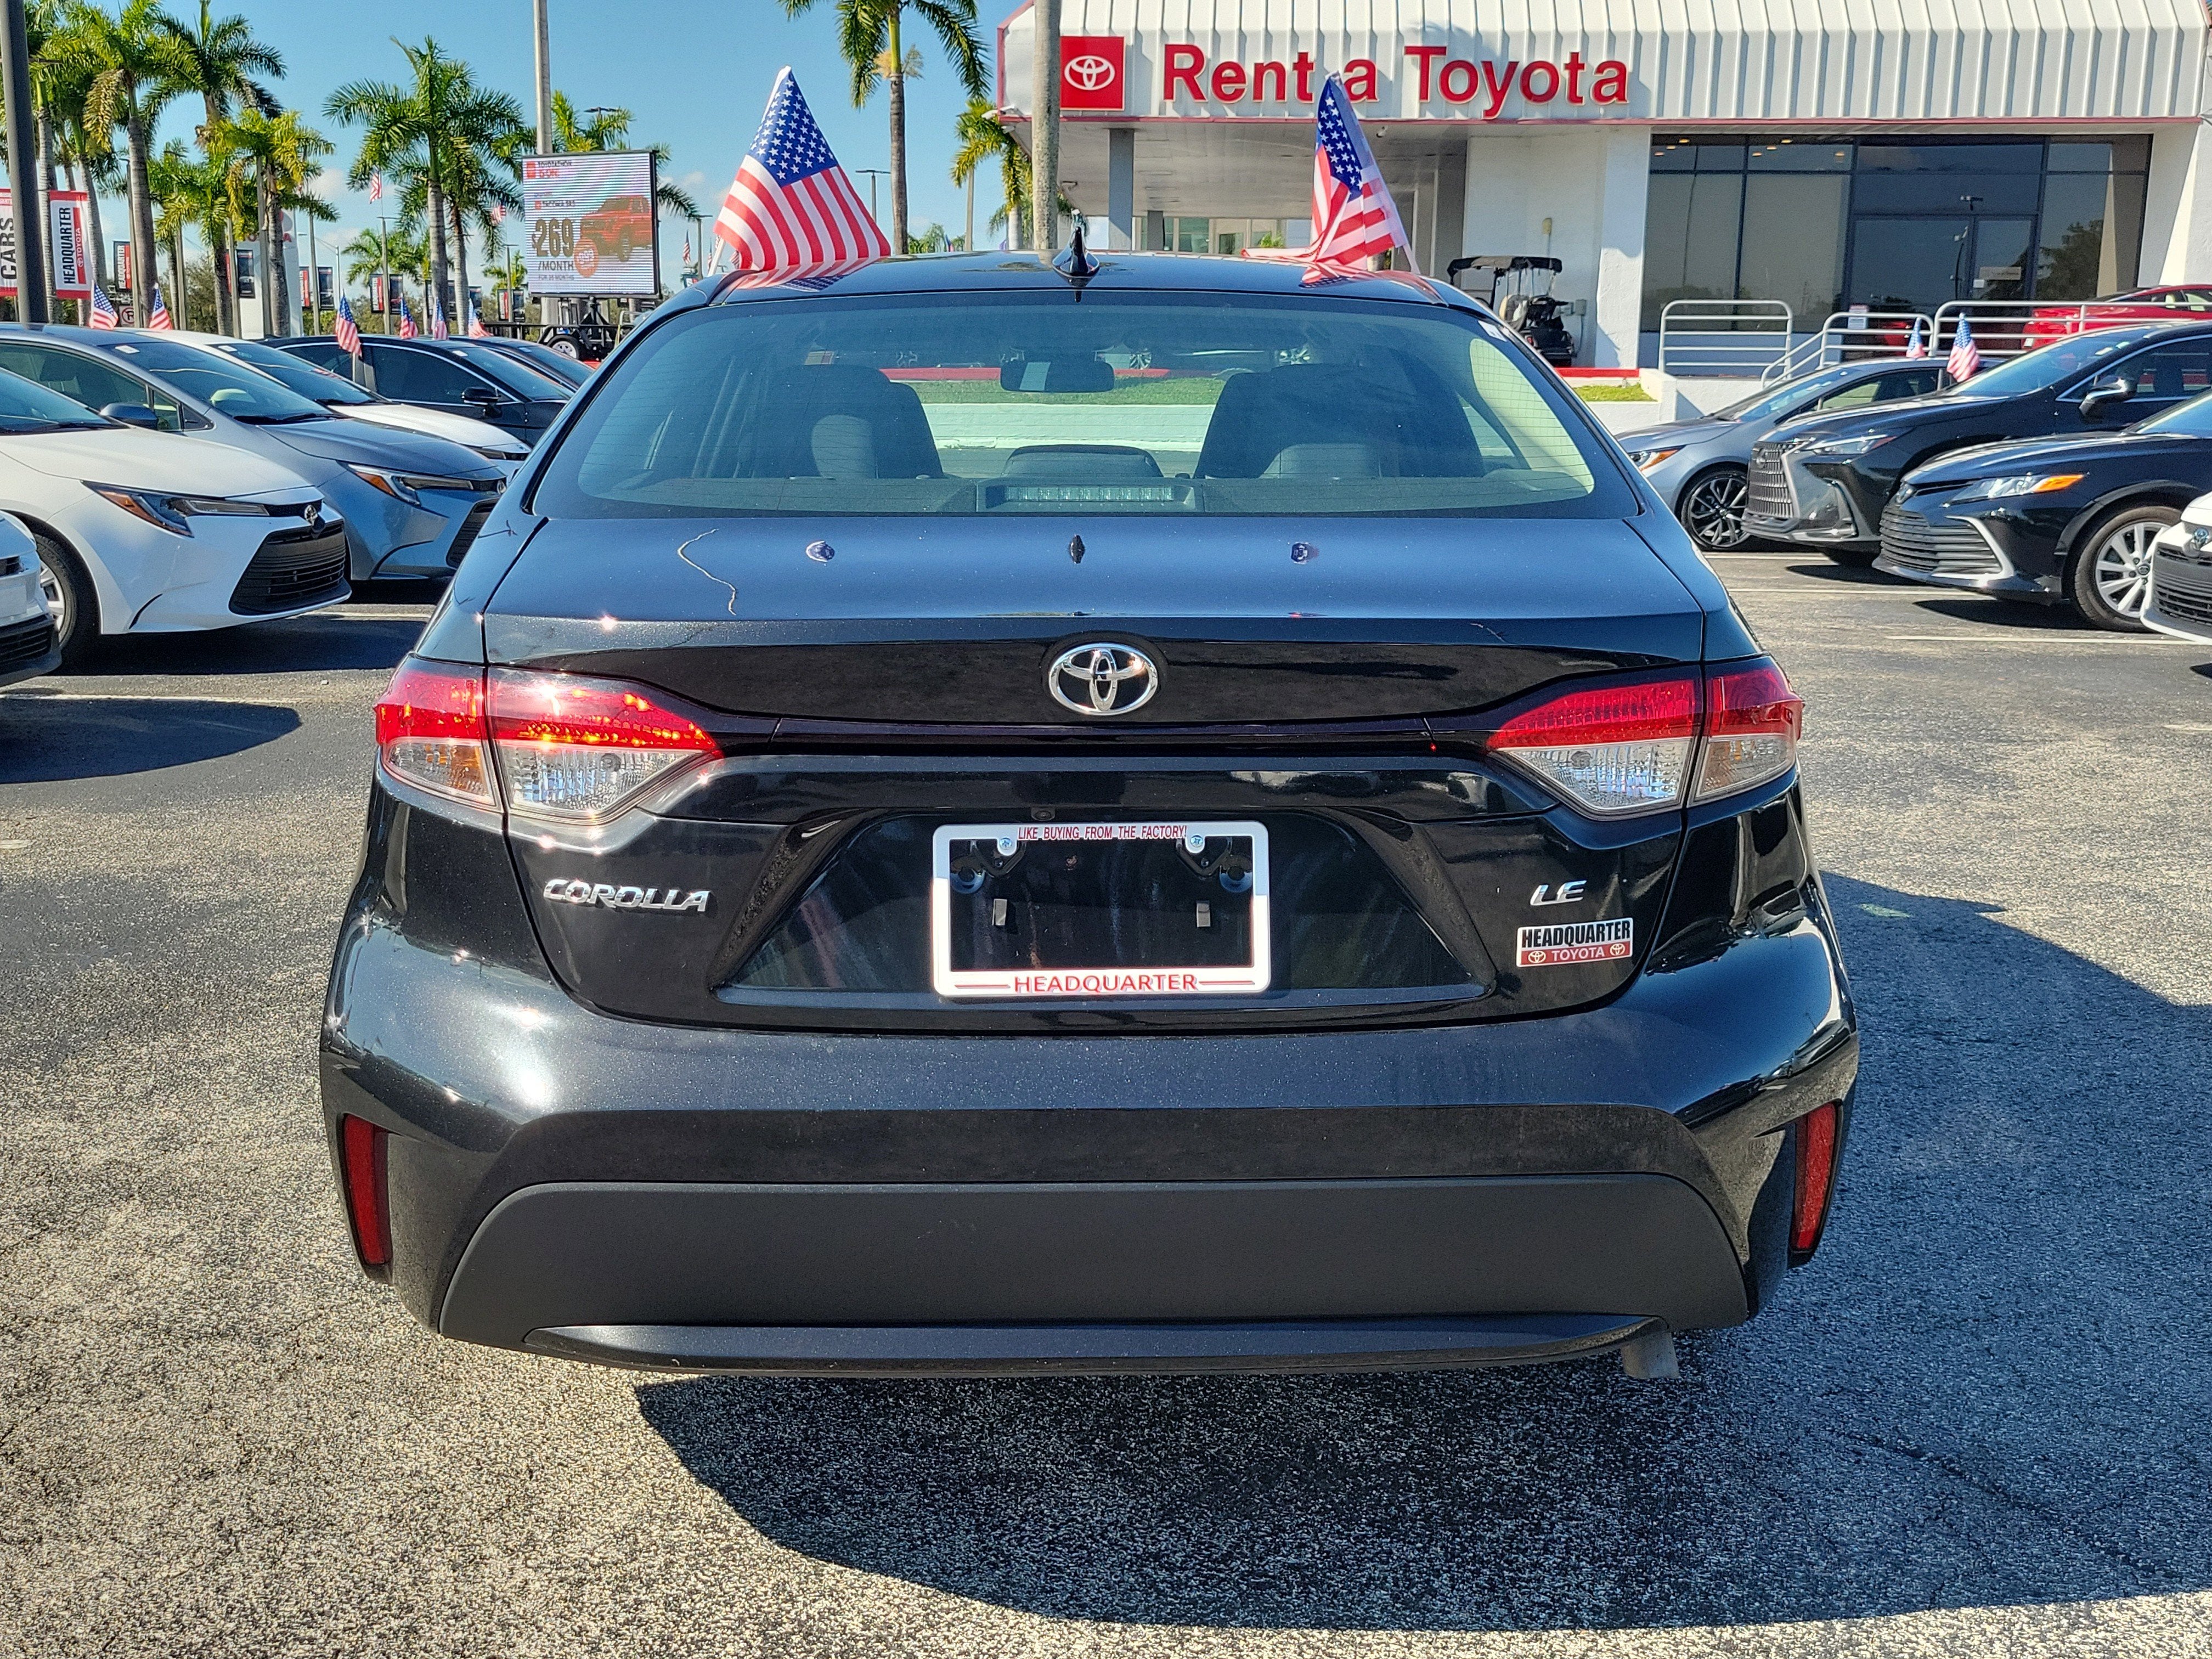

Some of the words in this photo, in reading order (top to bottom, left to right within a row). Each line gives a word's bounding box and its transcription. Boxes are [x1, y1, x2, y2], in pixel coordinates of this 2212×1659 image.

[1163, 44, 1314, 103] Rent
[1344, 59, 1379, 103] a
[1404, 45, 1629, 119] Toyota
[0, 217, 18, 280] CARS
[59, 207, 76, 284] HEADQUARTER
[76, 227, 84, 255] TOYOTA
[1018, 827, 1039, 839] LIKE
[1043, 826, 1080, 839] BUYING
[1085, 826, 1113, 839] FROM
[1118, 826, 1136, 838] THE
[1141, 825, 1187, 838] FACTORY!
[543, 878, 712, 912] COROLLA
[1530, 880, 1587, 906] LE
[1521, 921, 1630, 948] HEADQUARTER
[1551, 947, 1605, 961] TOYOTA
[1014, 974, 1197, 993] HEADQUARTER
